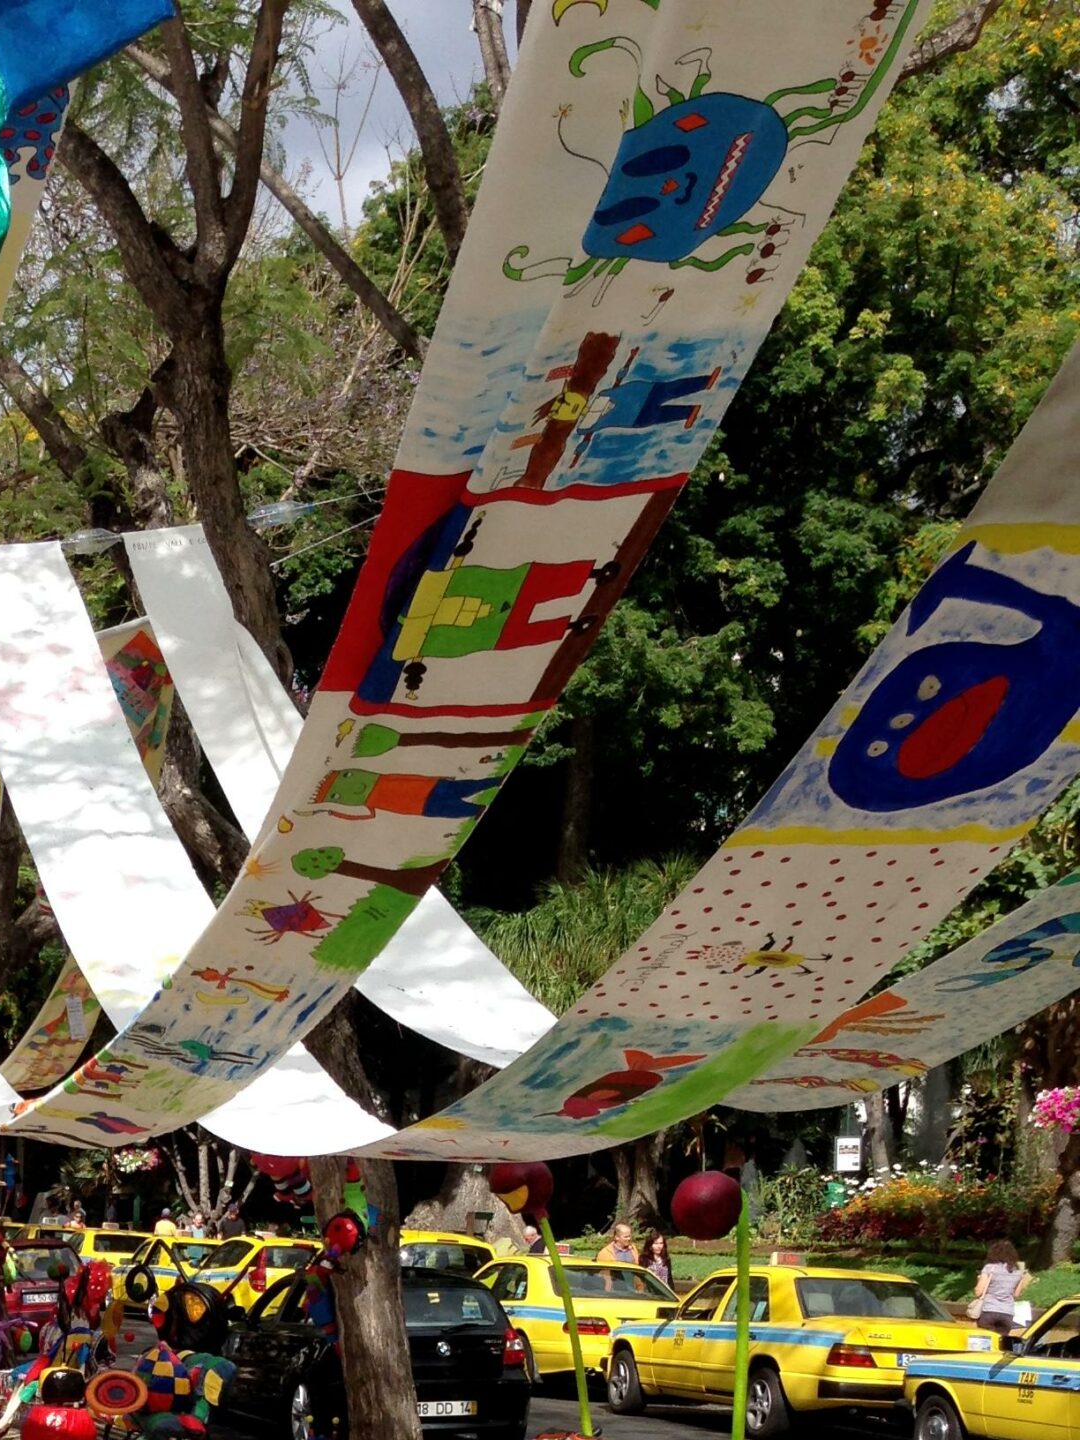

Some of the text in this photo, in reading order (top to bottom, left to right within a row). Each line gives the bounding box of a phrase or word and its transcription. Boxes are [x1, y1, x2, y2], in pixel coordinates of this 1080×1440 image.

[417, 1402, 472, 1415] 18 DD 14
